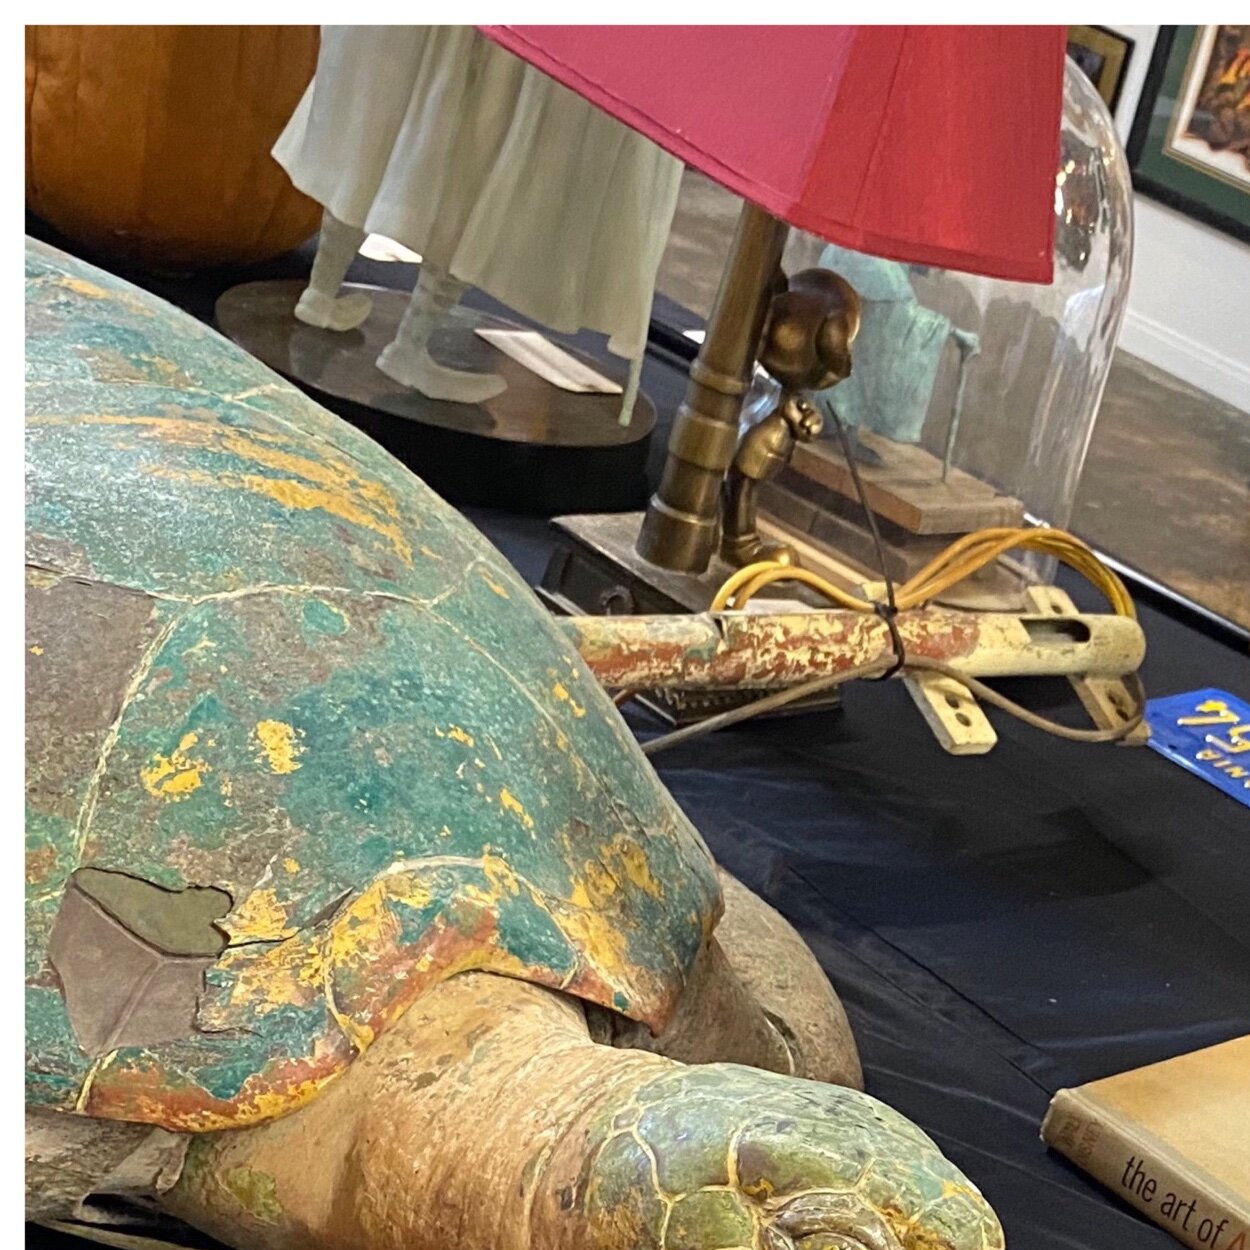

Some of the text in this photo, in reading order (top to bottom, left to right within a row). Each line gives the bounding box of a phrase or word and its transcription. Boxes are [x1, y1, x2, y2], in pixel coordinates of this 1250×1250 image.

[1121, 1155, 1157, 1202] the
[1160, 1192, 1197, 1231] art
[1197, 1217, 1229, 1249] of
